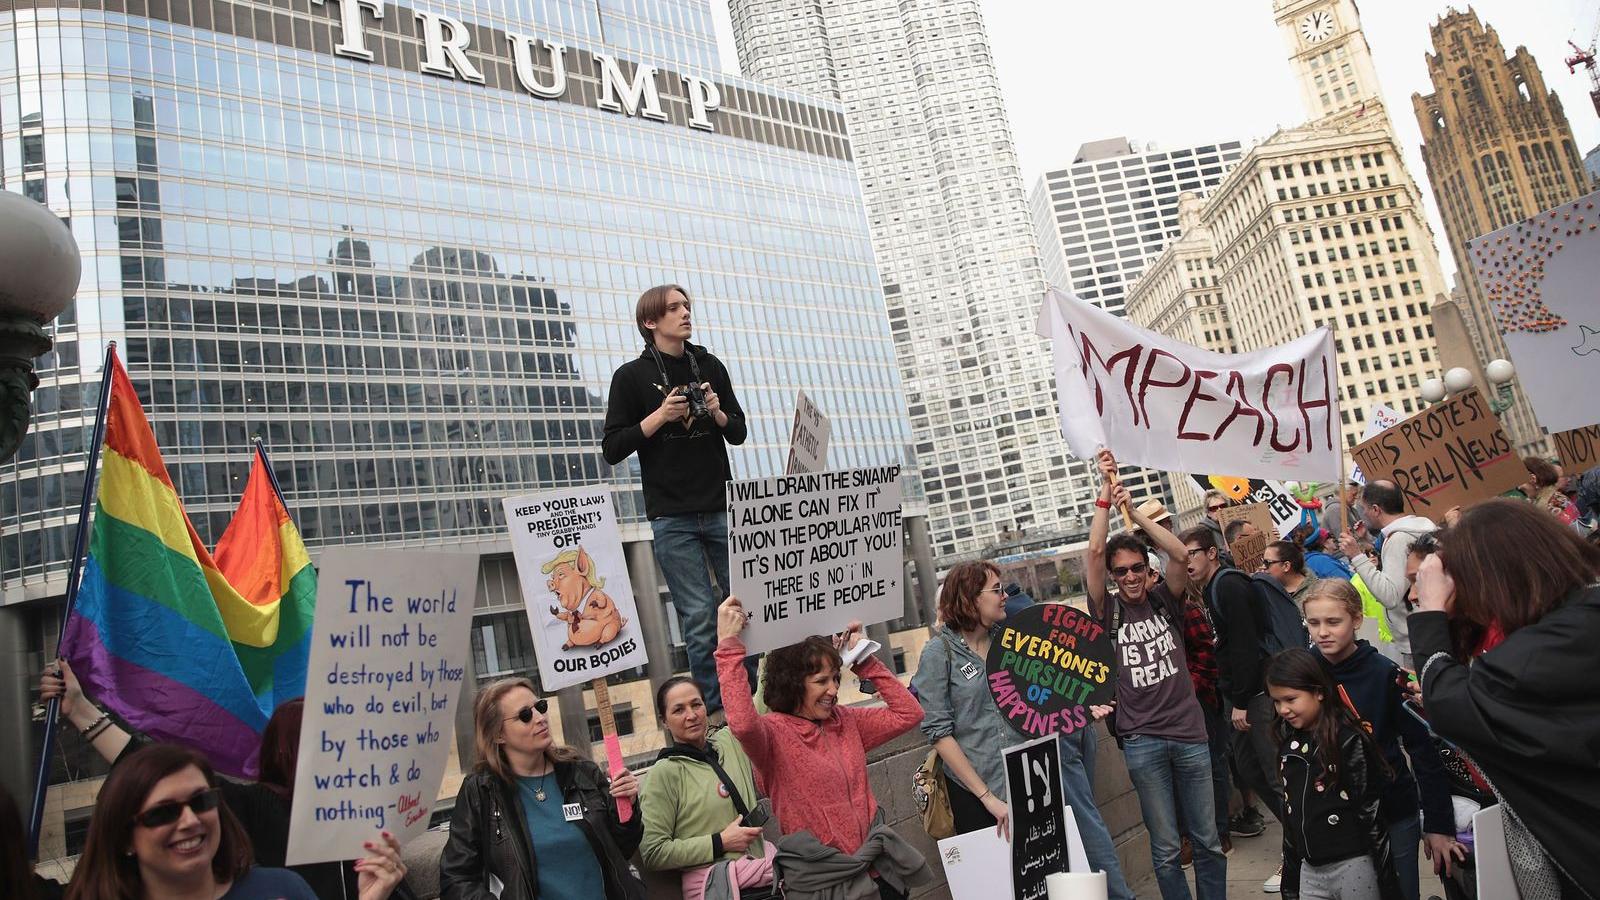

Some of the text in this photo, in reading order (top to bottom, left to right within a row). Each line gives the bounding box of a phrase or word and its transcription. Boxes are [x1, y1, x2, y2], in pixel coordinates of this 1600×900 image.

[313, 0, 720, 131] TRUMP
[1355, 391, 1485, 476] THIS PROTEST
[736, 480, 774, 502] WILL
[777, 475, 820, 497] DRAIN
[822, 471, 850, 491] THE
[1392, 429, 1511, 514] REAL NEWS
[515, 495, 605, 517] KEEP YOUR LAWS
[528, 511, 602, 533] PRESIDENT'S
[742, 503, 793, 526] ALONE
[799, 498, 830, 518] CAN
[838, 494, 859, 513] FIX
[552, 526, 576, 536] GRABBY
[576, 523, 597, 532] HANDS
[553, 532, 582, 548] OFF
[739, 529, 776, 552] WON
[780, 526, 807, 546] THE
[808, 515, 871, 541] POPULAR
[742, 531, 897, 578] IT'S NOT ABOUT YOU!
[345, 580, 457, 614] The world
[764, 575, 803, 599] THERE
[809, 571, 820, 590] IS
[827, 566, 844, 586] NO
[862, 561, 873, 577] IN
[764, 580, 886, 622] WE THE PEOPLE
[330, 622, 437, 648] will not be
[1042, 604, 1104, 641] FIGHT
[1049, 629, 1077, 649] FOR
[553, 638, 637, 672] OUR BODIES
[1001, 628, 1110, 684] EVERYONE'S
[1122, 631, 1177, 666] IS FOR
[327, 657, 464, 692] destroyed by those
[962, 663, 976, 677] NO!
[1000, 651, 1095, 705] PURSUIT
[1131, 655, 1179, 688] REAL
[324, 691, 448, 715] who do evil, but
[988, 670, 1087, 736] HAPPINESS
[1027, 684, 1052, 705] OF
[322, 722, 440, 762] by those who
[314, 759, 421, 790] watch & do
[564, 805, 582, 817] NO!
